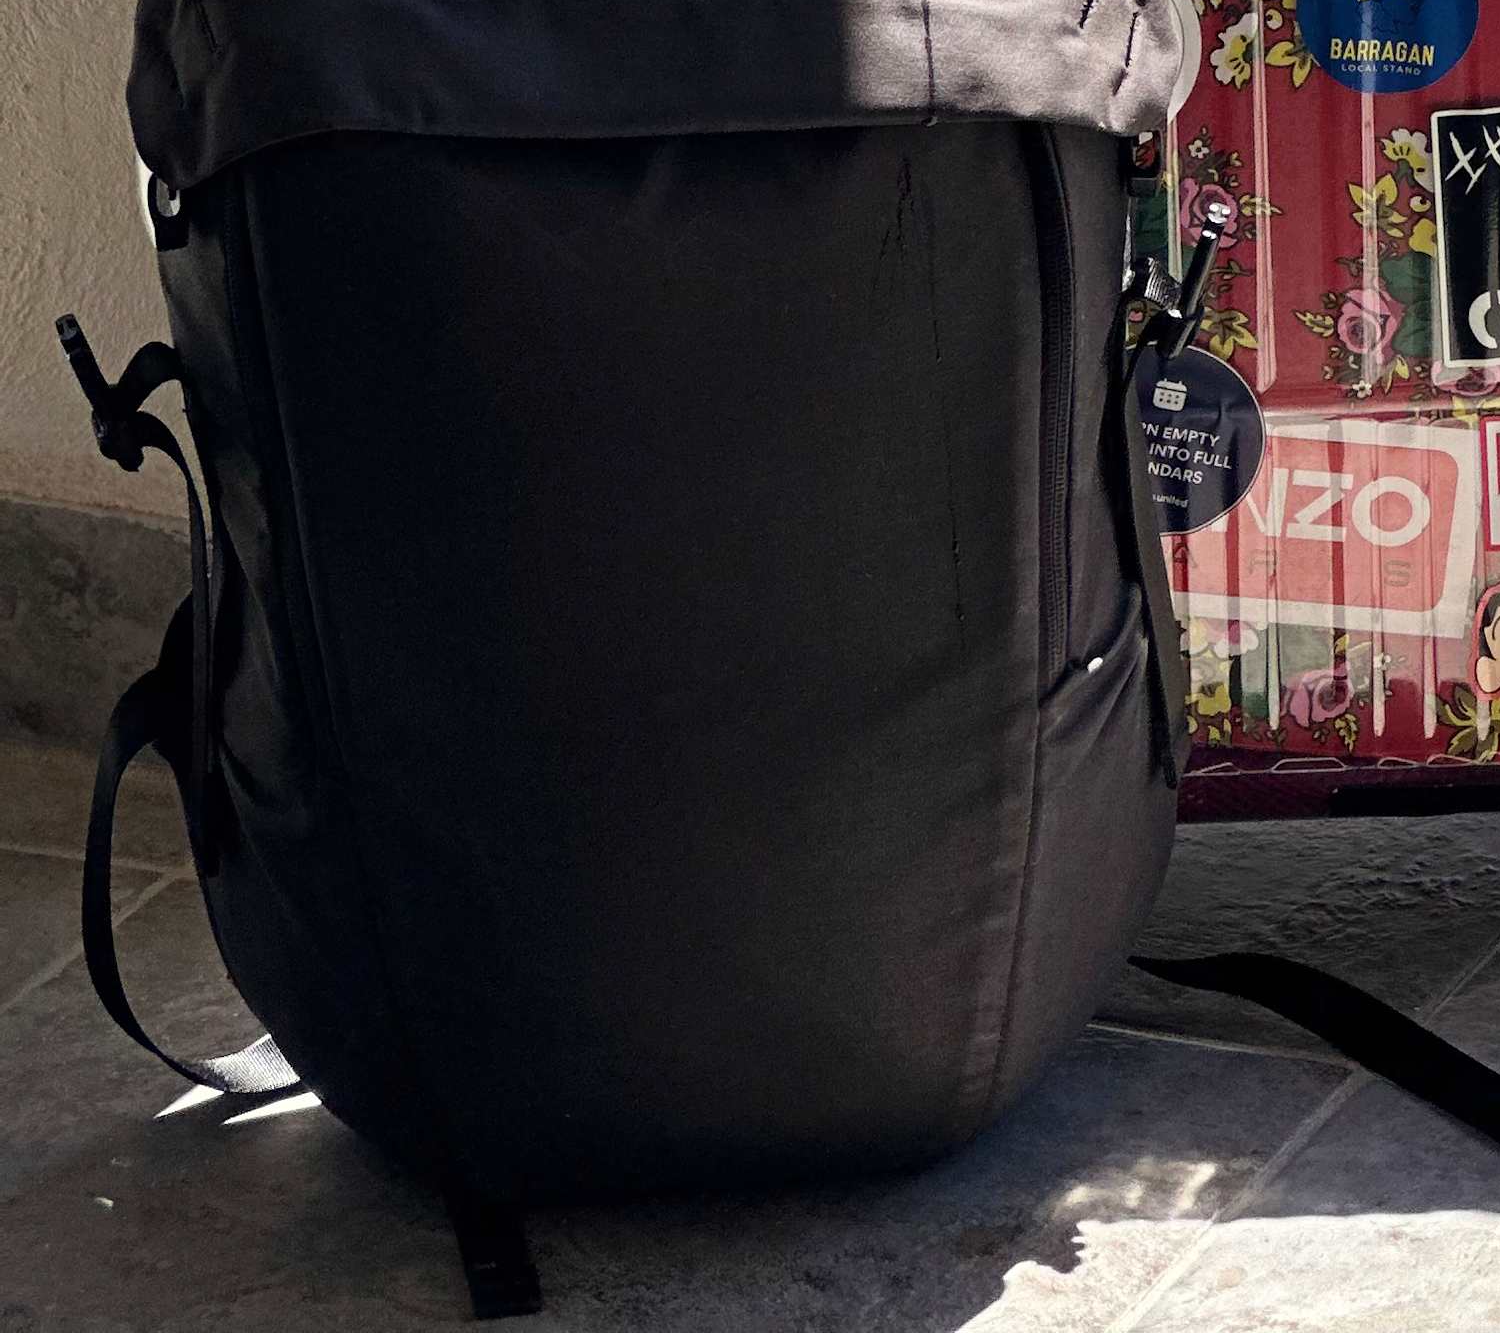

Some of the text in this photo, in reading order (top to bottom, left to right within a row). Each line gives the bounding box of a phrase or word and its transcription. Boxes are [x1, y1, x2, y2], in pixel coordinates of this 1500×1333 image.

[1330, 38, 1435, 66] BARRAGAN
[1341, 63, 1422, 76] LOCAL STAND
[1162, 427, 1220, 448] EMPTY
[1150, 443, 1232, 469] INTO FULL
[1148, 462, 1203, 485] NDARS
[1213, 468, 1431, 547] NZO
